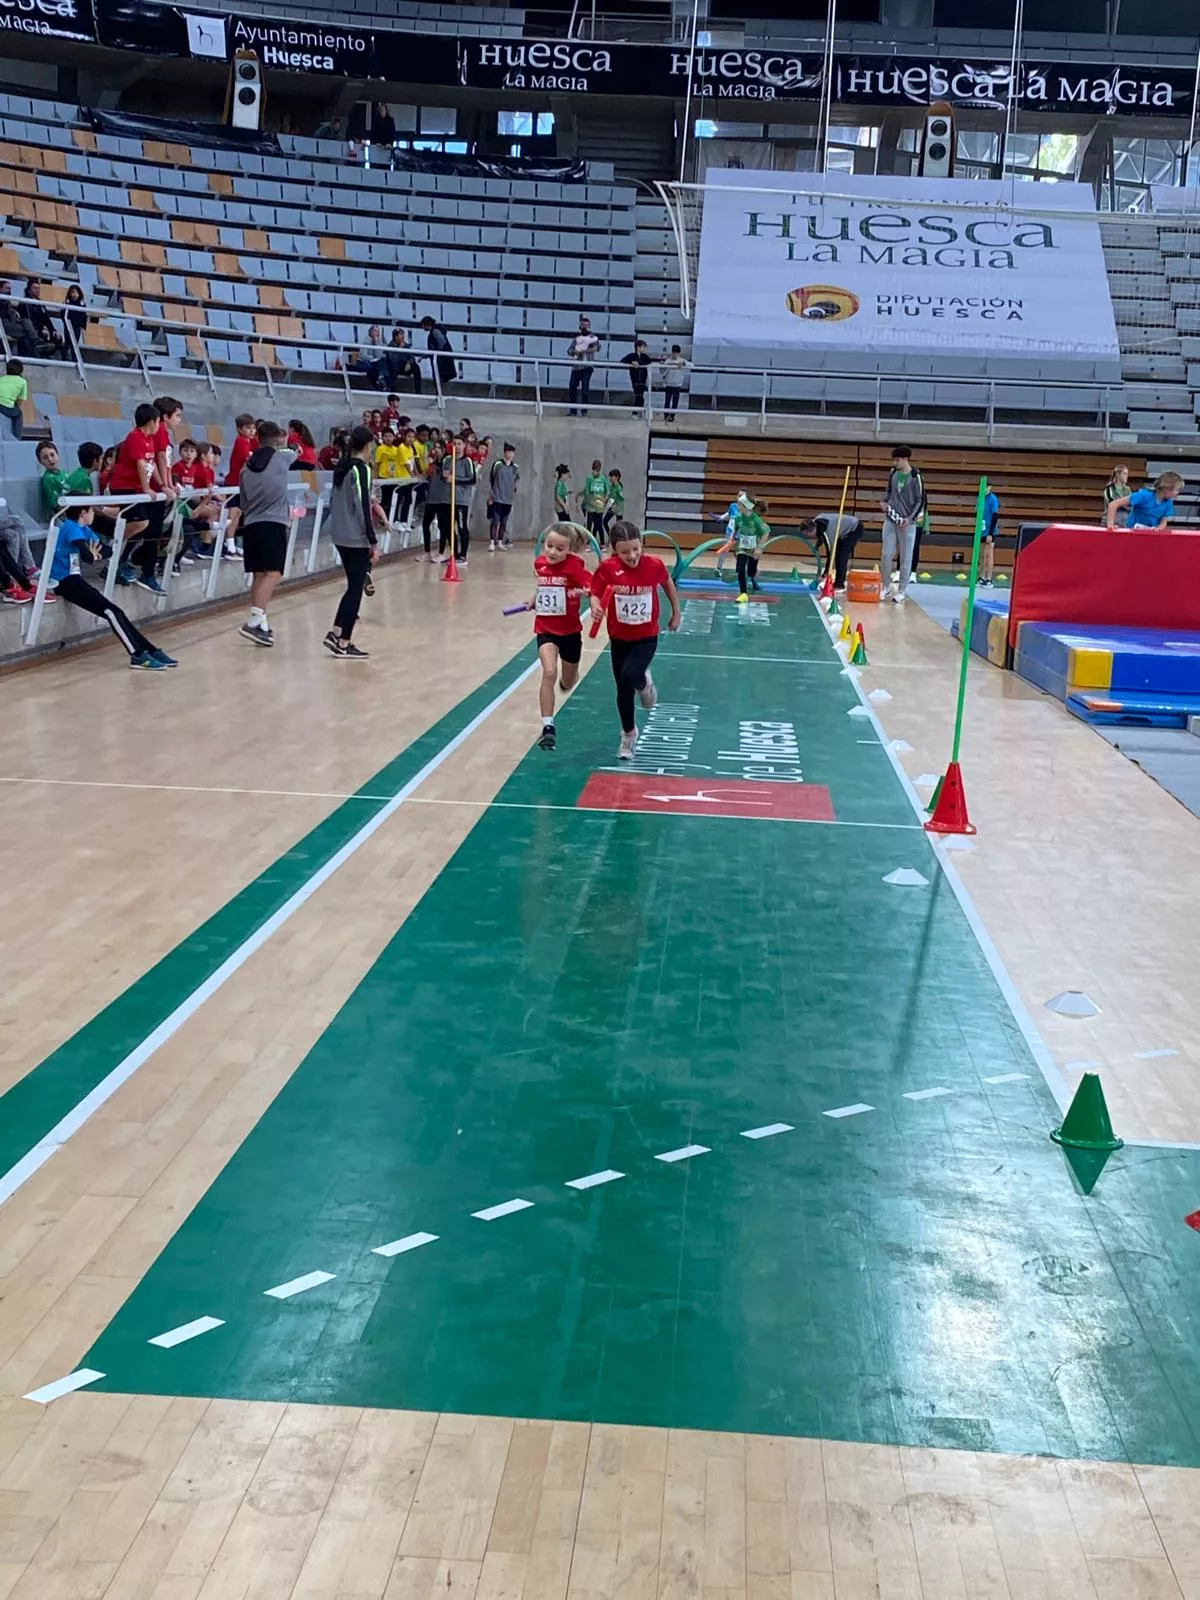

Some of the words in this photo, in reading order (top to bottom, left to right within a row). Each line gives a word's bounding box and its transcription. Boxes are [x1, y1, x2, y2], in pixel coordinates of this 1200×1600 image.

[234, 21, 366, 52] Ayuntamiento
[263, 46, 335, 70] Huesca
[478, 42, 612, 73] Huesca
[669, 51, 803, 80] Huesca
[504, 72, 526, 88] La
[692, 83, 714, 97] La
[848, 66, 995, 98] Huesca
[743, 211, 1060, 249] Huesca
[785, 242, 840, 264] La
[876, 294, 1024, 309] DIPUTACIÓN
[876, 306, 1024, 321] HUESCA
[537, 595, 558, 607] 431
[622, 603, 647, 616] 422
